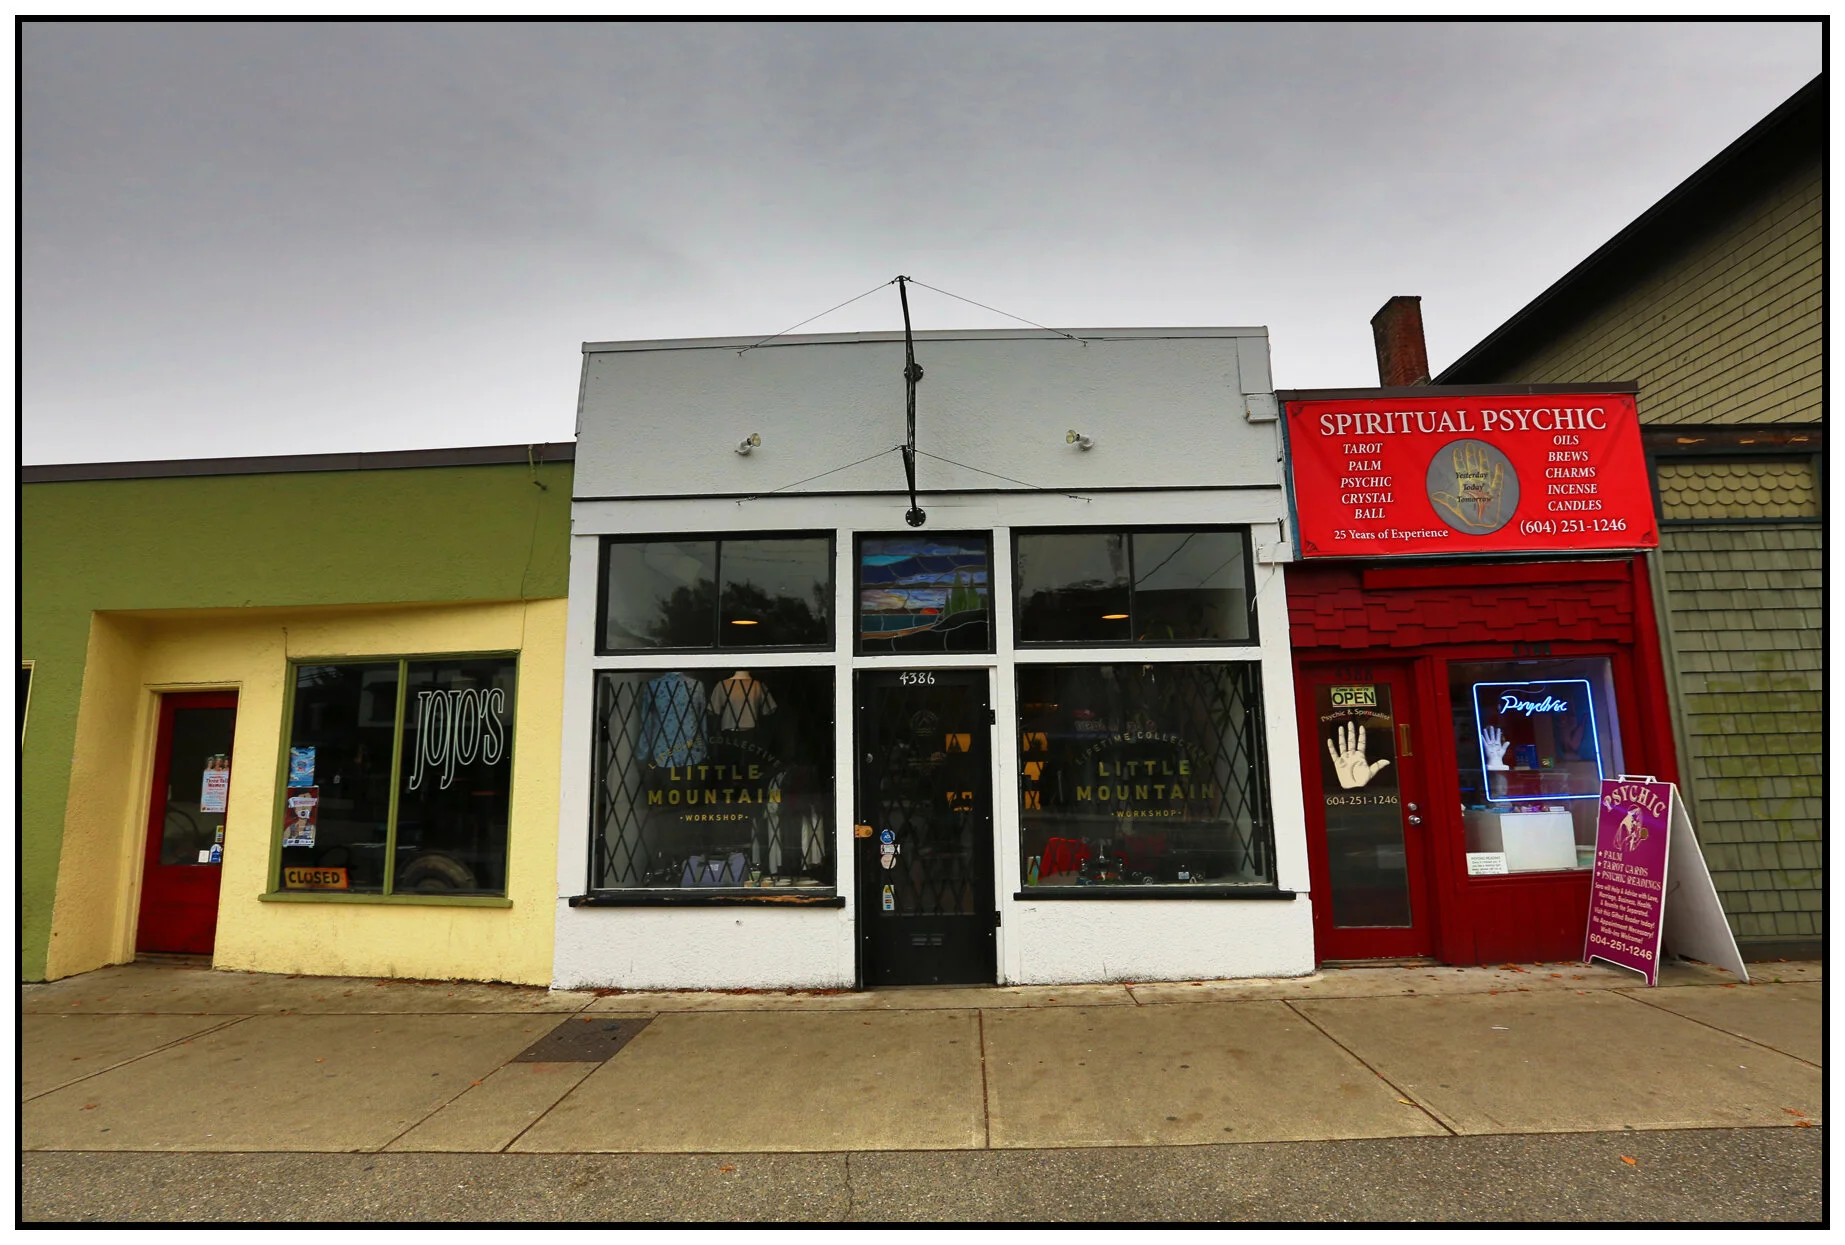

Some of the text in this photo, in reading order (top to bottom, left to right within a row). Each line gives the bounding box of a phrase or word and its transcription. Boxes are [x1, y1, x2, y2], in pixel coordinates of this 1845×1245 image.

[1320, 408, 1606, 436] SPIRITUAL PSYCHIC
[1553, 435, 1579, 445] OILS
[1343, 443, 1383, 454] TAROT
[1548, 451, 1588, 462] BREWS
[1348, 460, 1381, 471] PALM
[1455, 471, 1488, 480] Yesterday
[1545, 467, 1596, 478] CHARMS
[1340, 476, 1392, 488] PSYCHIC
[1463, 483, 1485, 492] Today
[1547, 484, 1598, 495] INCENSE
[1341, 492, 1394, 504] CRYSTAL
[1548, 500, 1602, 511] CANDLES
[1354, 508, 1386, 519] BALL
[1520, 518, 1627, 536] (604) 251-1246
[1334, 528, 1449, 541] 25 Years of Experience
[899, 671, 935, 685] 4386
[1332, 691, 1375, 705] OPEN
[1500, 695, 1568, 716] Psychic
[1321, 710, 1346, 722] Psychic
[1354, 708, 1390, 721] Spiritualist
[409, 687, 505, 790] JOJO'S
[709, 736, 783, 767] COLLECTIVE
[1075, 732, 1131, 766] LIFETIME
[670, 764, 761, 781] LITTLE
[1098, 759, 1191, 777] LITTLE
[647, 788, 782, 805] MOUNTAIN
[1076, 783, 1214, 801] MOUNTAIN
[1326, 794, 1398, 805] 604-251-1246
[1602, 785, 1666, 818] PSYCHIC
[685, 813, 744, 821] WORKSHOP
[1117, 809, 1177, 817] WORKSHOP
[1603, 850, 1623, 861] PALM
[1603, 860, 1648, 877] TAROT CARDS
[288, 871, 340, 884] CLOSED
[1601, 871, 1661, 891] PSYCHIC READINGS
[1590, 933, 1653, 961] 604-251-1246
